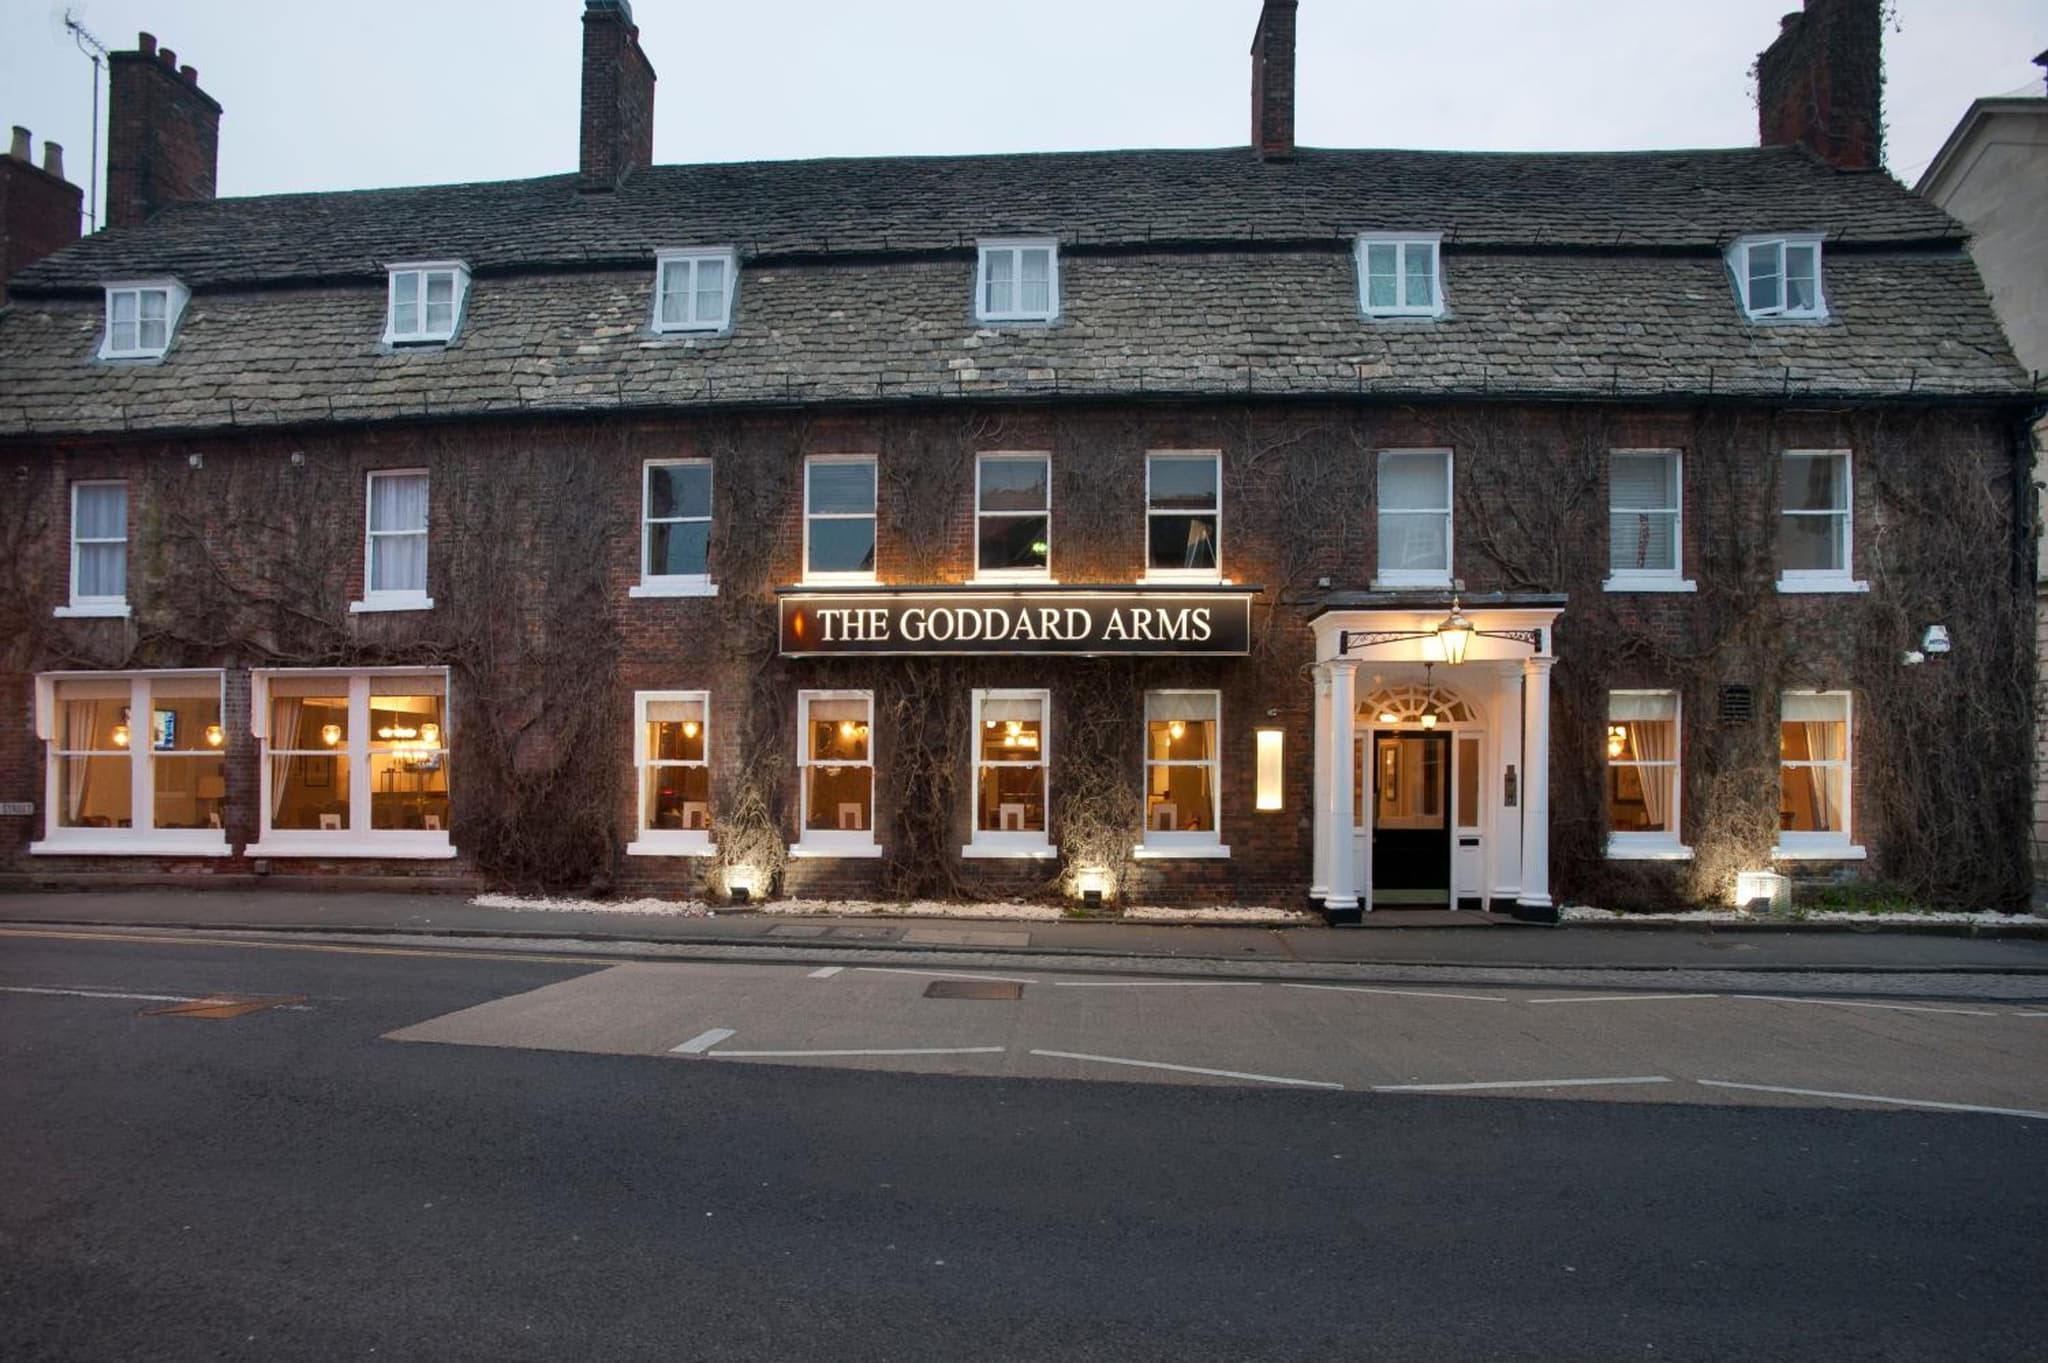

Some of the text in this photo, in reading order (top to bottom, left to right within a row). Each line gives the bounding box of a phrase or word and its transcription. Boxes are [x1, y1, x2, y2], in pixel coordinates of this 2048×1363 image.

[817, 608, 1212, 641] THE GODDARD ARMS
